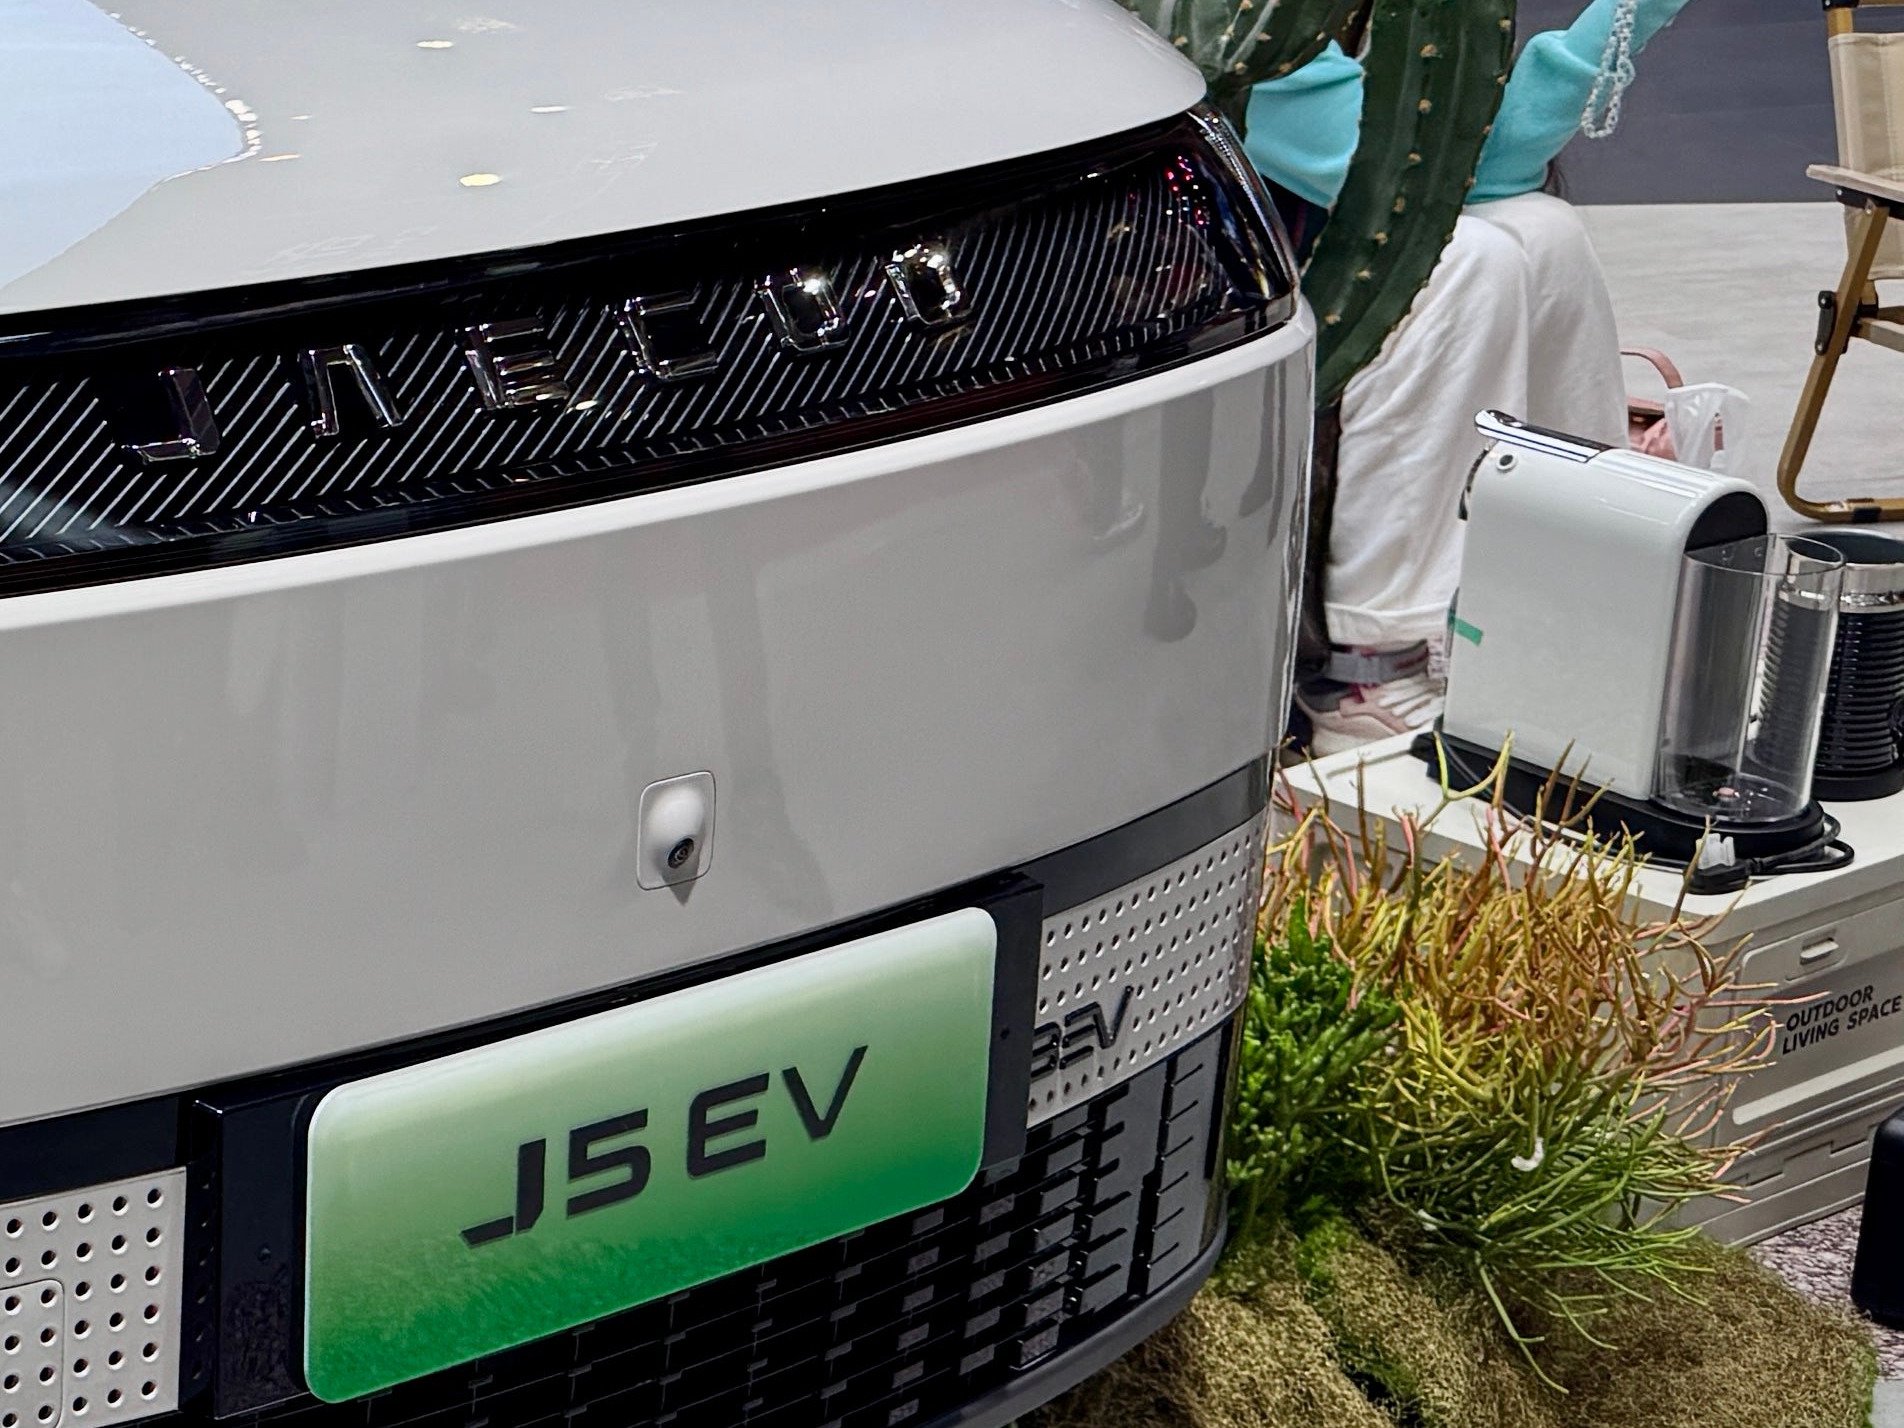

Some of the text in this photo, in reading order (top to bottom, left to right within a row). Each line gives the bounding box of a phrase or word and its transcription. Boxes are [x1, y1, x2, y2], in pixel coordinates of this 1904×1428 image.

[120, 242, 976, 464] JAECOO
[1782, 995, 1903, 1056] LIVING SPACE
[1786, 985, 1874, 1032] OUTDOOR
[460, 1044, 868, 1248] J5 EV
